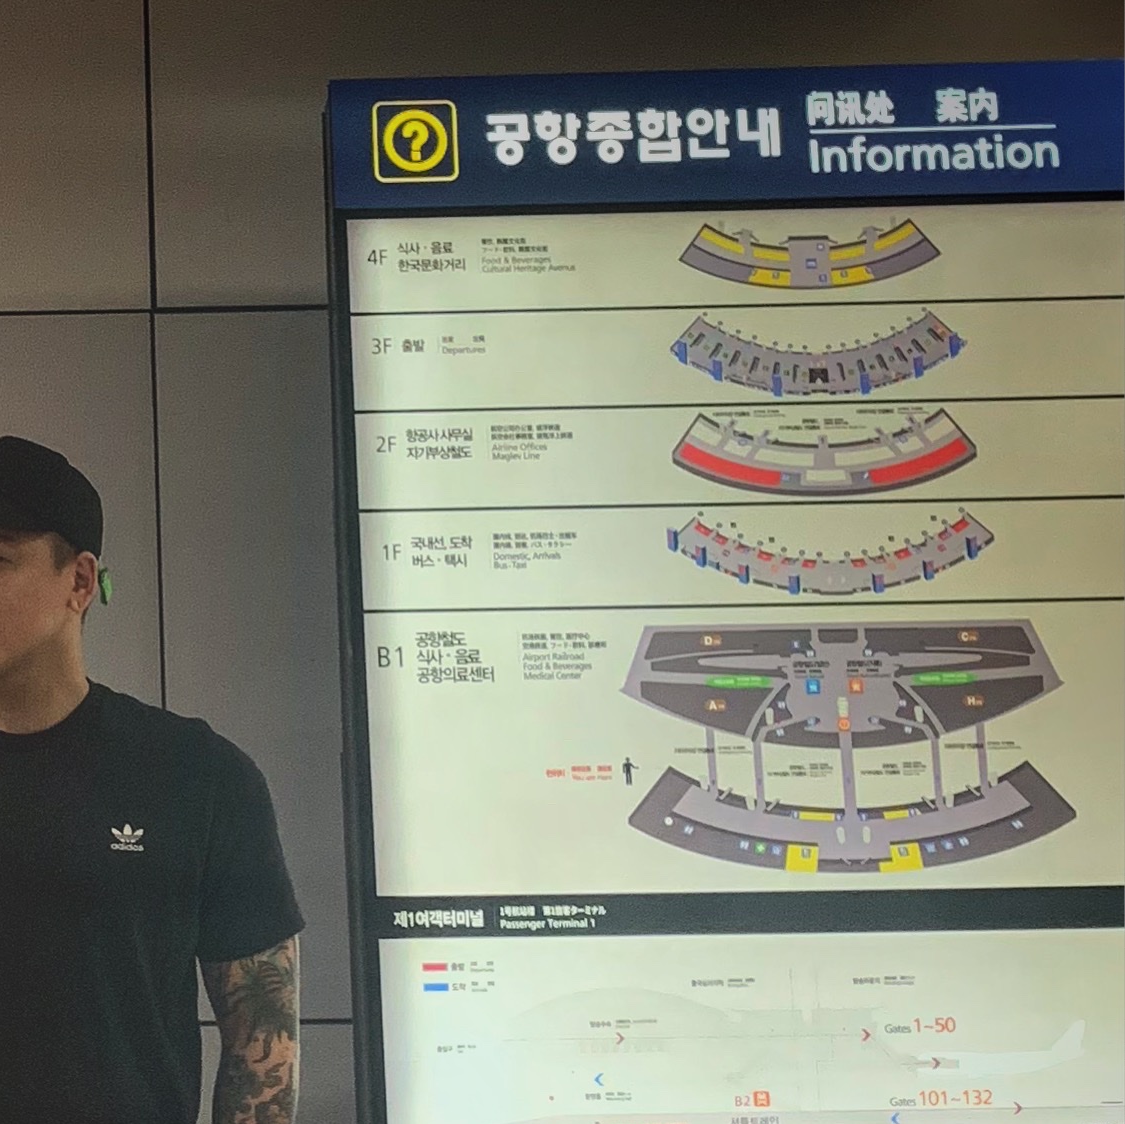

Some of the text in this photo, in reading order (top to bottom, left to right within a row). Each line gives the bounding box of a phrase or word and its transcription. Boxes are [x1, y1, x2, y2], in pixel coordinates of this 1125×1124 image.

[806, 87, 999, 125] 问讯处 案内
[486, 108, 781, 166] 공항종합안내
[809, 133, 1060, 173] Information
[397, 242, 420, 255] 식사
[430, 241, 454, 255] 음료
[367, 249, 387, 265] 4F
[481, 256, 502, 264] Food
[511, 256, 551, 266] Beverages
[398, 258, 466, 272] 한국문화거리
[482, 265, 512, 273] Cultural
[513, 264, 547, 274] Heritage
[371, 338, 392, 354] 3F
[442, 346, 486, 356] Departures
[406, 427, 473, 443] 항공사 사무실
[376, 436, 397, 453] 2F
[492, 442, 548, 451] Airline Offices
[406, 445, 473, 460] 자기부상철도
[492, 452, 540, 462] Maglev Line
[449, 535, 473, 550] 도착
[383, 544, 401, 561] 1F
[532, 551, 562, 560] Arrivals
[412, 554, 435, 568] 버스
[444, 553, 467, 568] 택시
[415, 631, 467, 648] 공항철도
[377, 646, 403, 668] B1
[416, 649, 443, 665] 식사
[454, 648, 482, 665] 음료
[522, 652, 585, 662] Airport Railroad
[523, 661, 544, 671] Food
[552, 661, 593, 672] Beverages
[416, 666, 495, 684] 공항의료센터
[523, 671, 582, 680] Medical Center
[393, 909, 484, 928] 제1여객터미널
[500, 918, 596, 931] Passenger Terminal 1
[884, 1016, 957, 1034] Gates 1~50
[734, 1095, 750, 1107] B2
[889, 1089, 993, 1107] Gates 101~132
